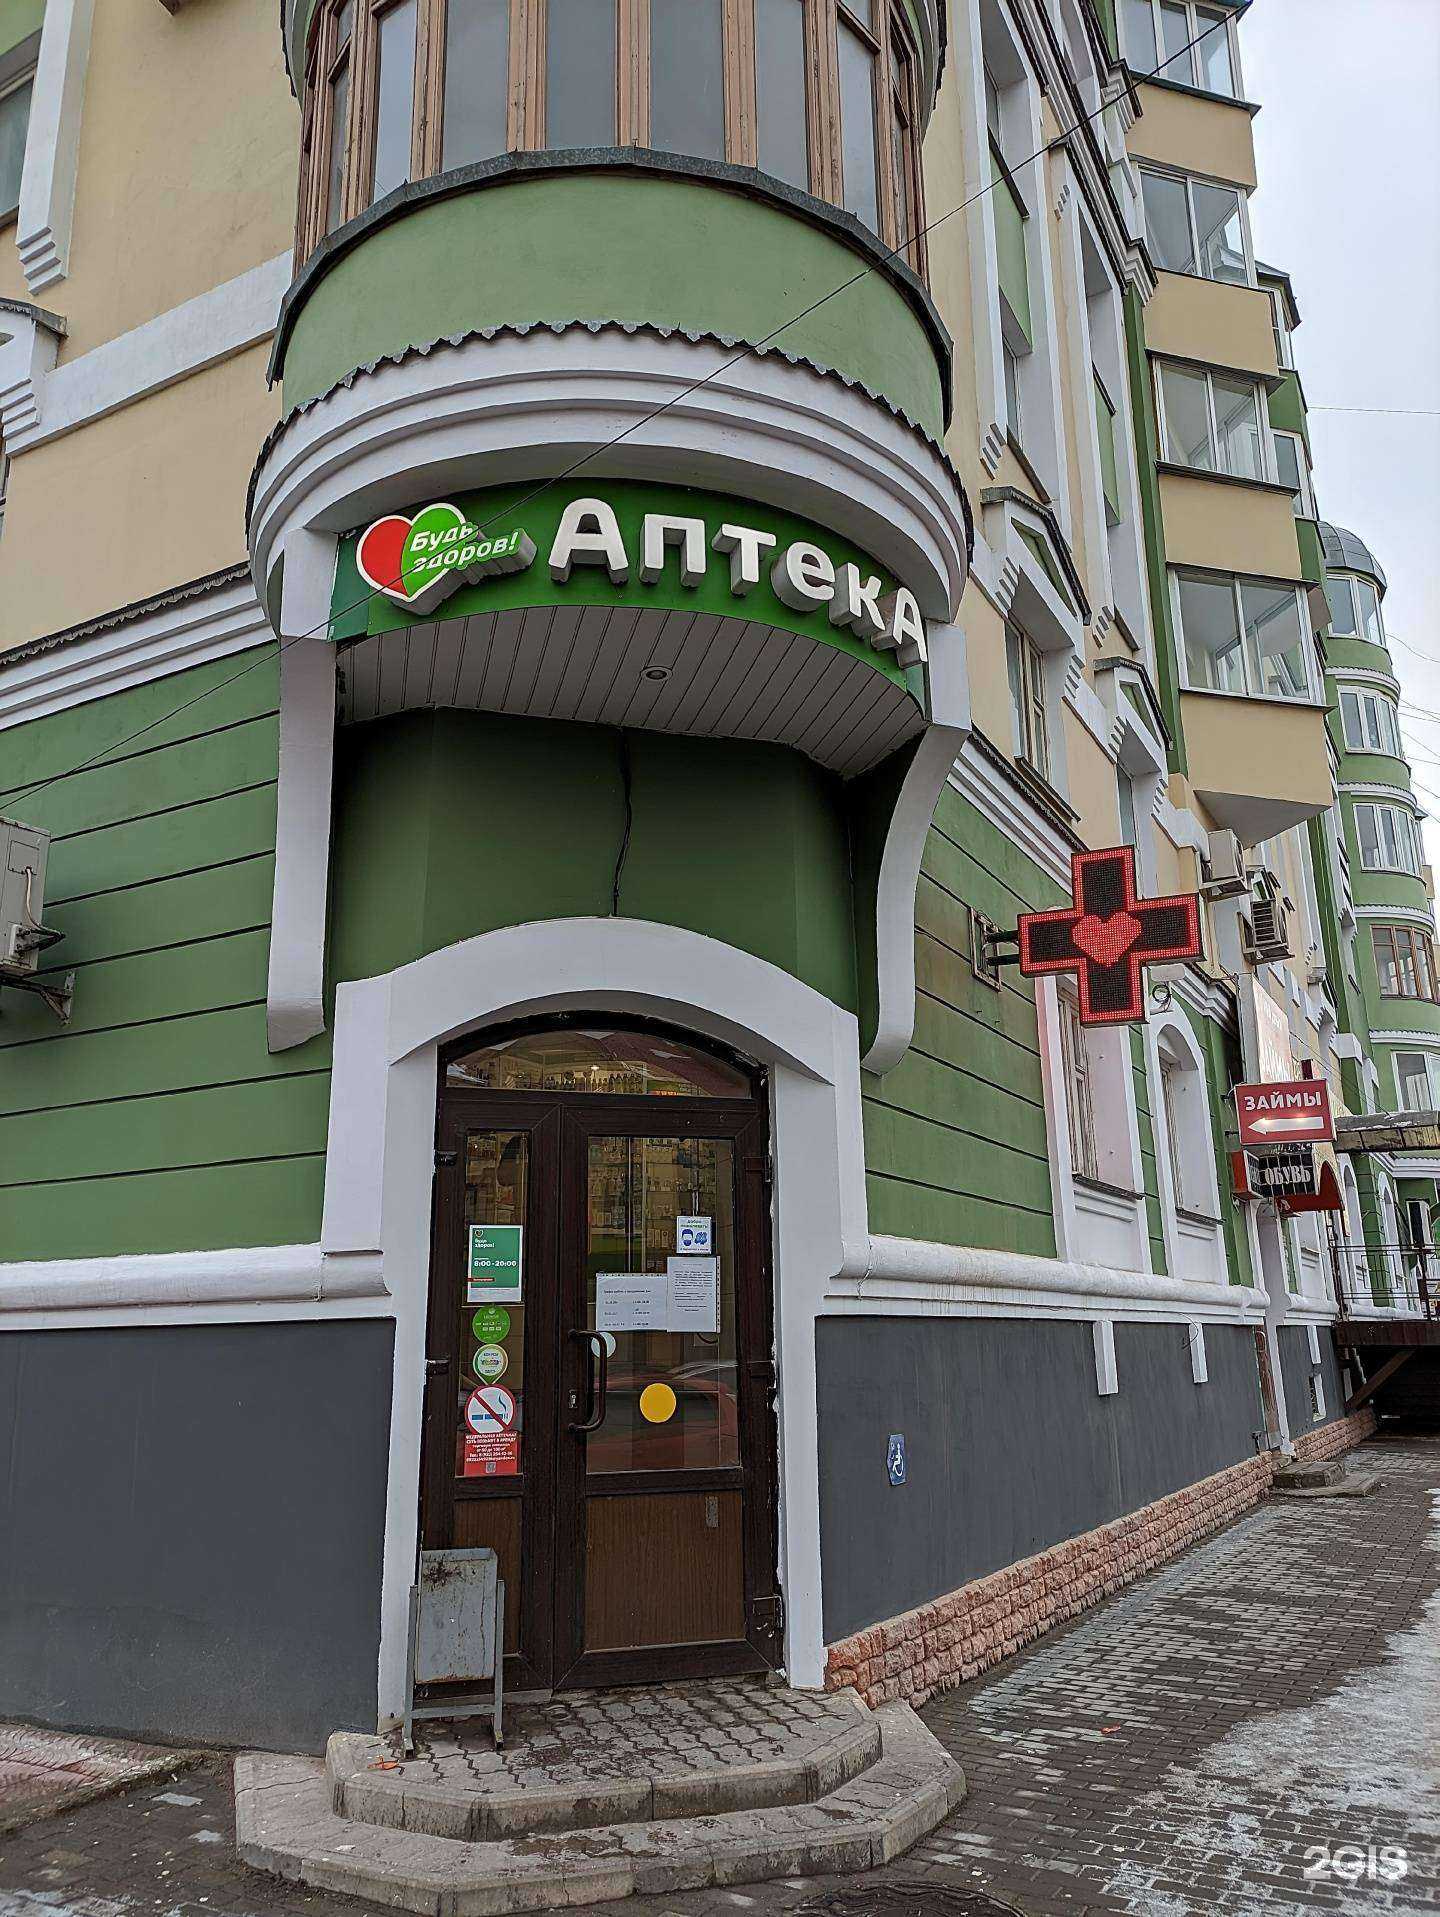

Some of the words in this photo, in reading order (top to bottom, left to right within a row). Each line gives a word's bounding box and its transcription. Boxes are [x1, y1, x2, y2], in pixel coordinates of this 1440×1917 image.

[410, 525, 474, 552] Будь
[412, 531, 519, 573] здоров!
[1244, 1091, 1322, 1111] ЗАЙМЫ
[1264, 1165, 1311, 1186] ОБУВЬ
